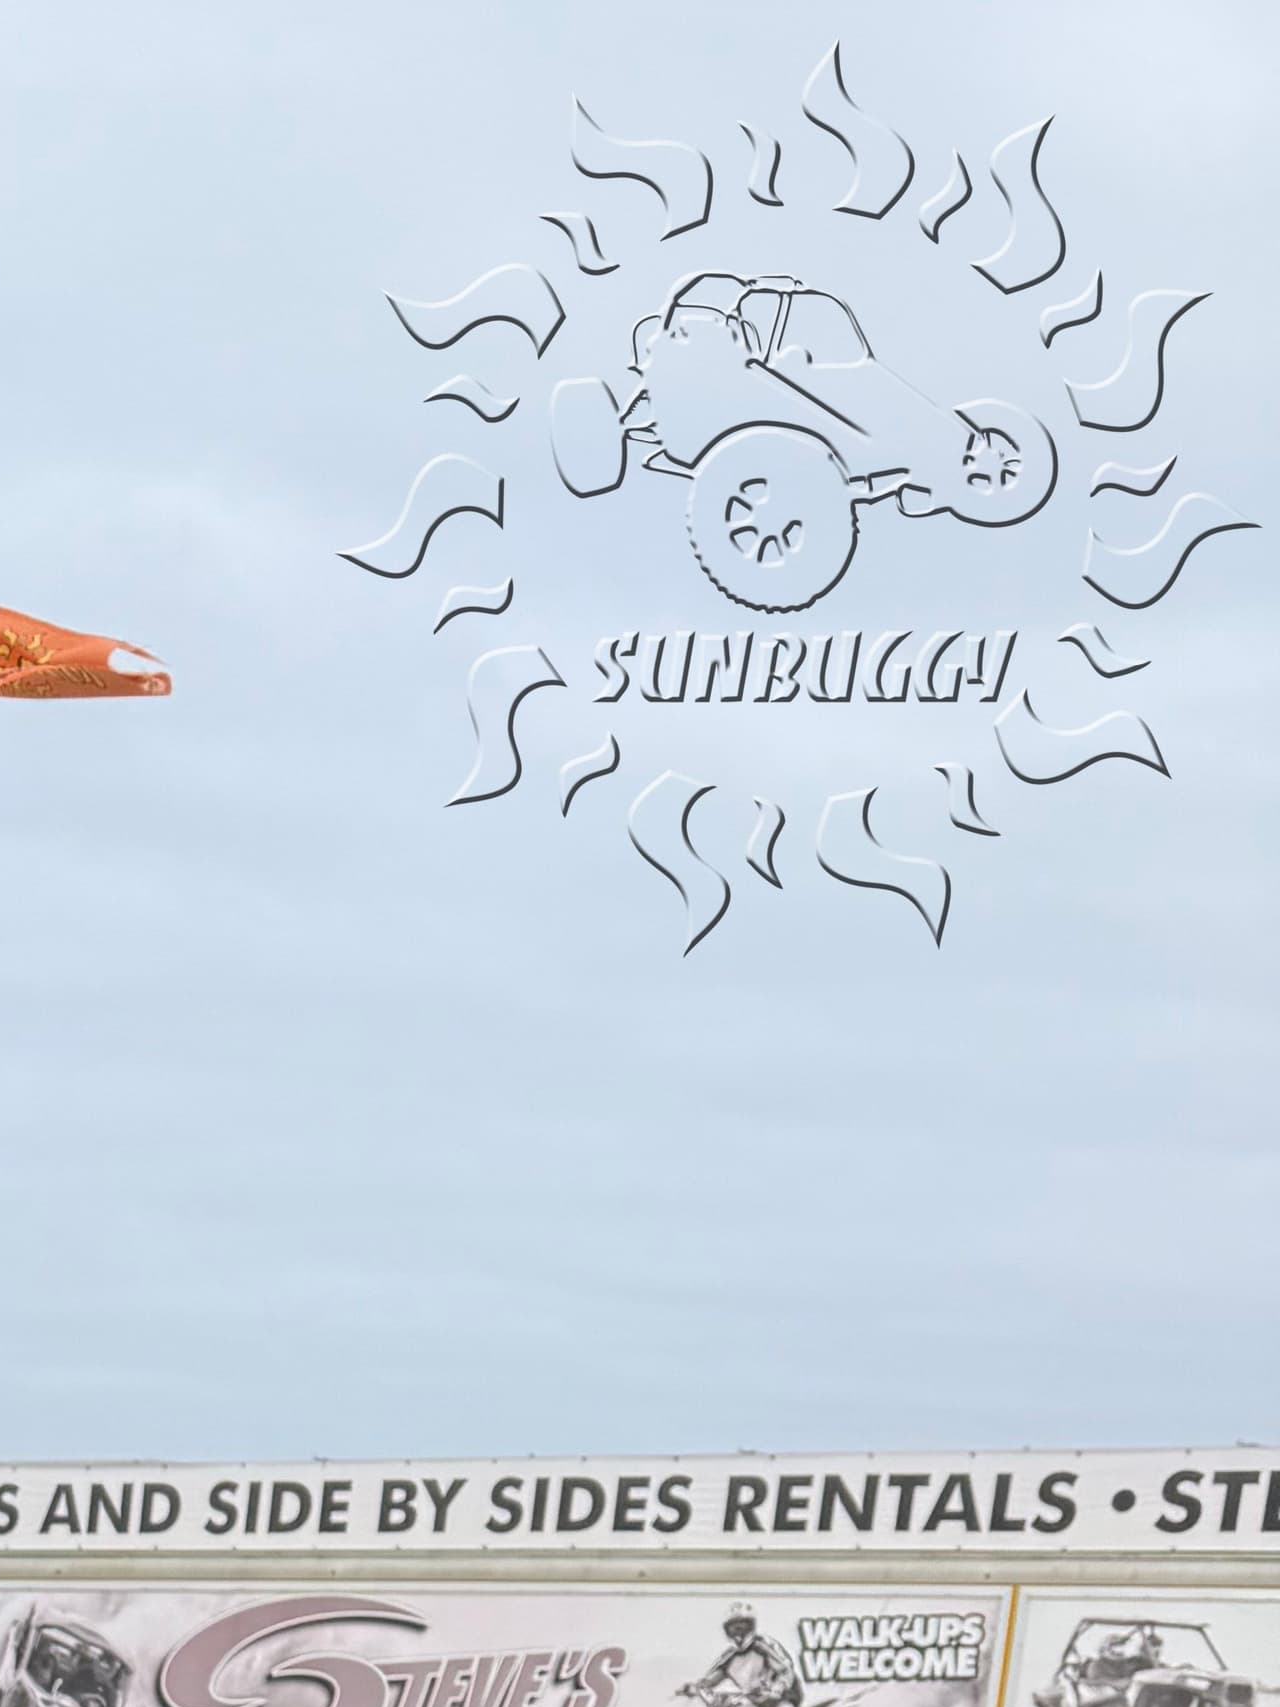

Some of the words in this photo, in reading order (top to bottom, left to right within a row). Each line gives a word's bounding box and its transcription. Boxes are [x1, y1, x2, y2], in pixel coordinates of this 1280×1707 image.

[40, 1481, 182, 1535] AND
[206, 1479, 352, 1535] SIDE
[378, 1477, 467, 1533] BY
[485, 1474, 693, 1534] SIDES
[723, 1470, 1080, 1534] RENTALS
[798, 1612, 986, 1649] WALK-UPS
[800, 1645, 980, 1682] WELCOME
